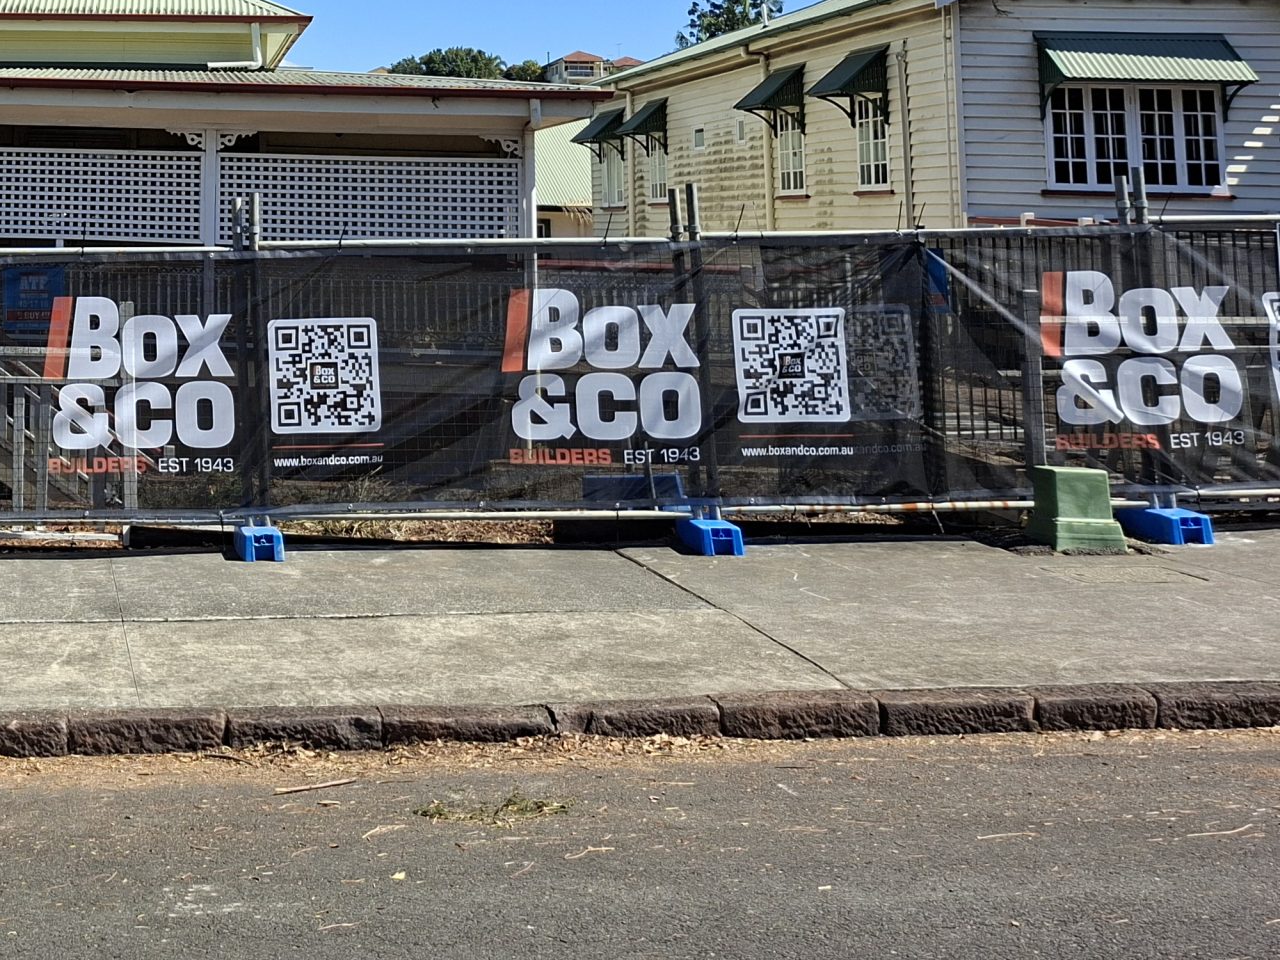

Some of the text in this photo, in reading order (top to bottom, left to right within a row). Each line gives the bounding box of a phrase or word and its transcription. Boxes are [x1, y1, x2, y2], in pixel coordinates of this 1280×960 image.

[1056, 354, 1243, 426] &CO
[53, 380, 235, 449] &CO
[511, 371, 702, 440] &CO
[1056, 431, 1245, 450] BUILDERS EST 1943
[509, 447, 700, 465] BUILDERS EST 1943
[741, 444, 853, 456] www.boxandco.com.au
[48, 457, 234, 474] BUILDERS EST 1943
[274, 454, 383, 467] www.boxandco.com.au
